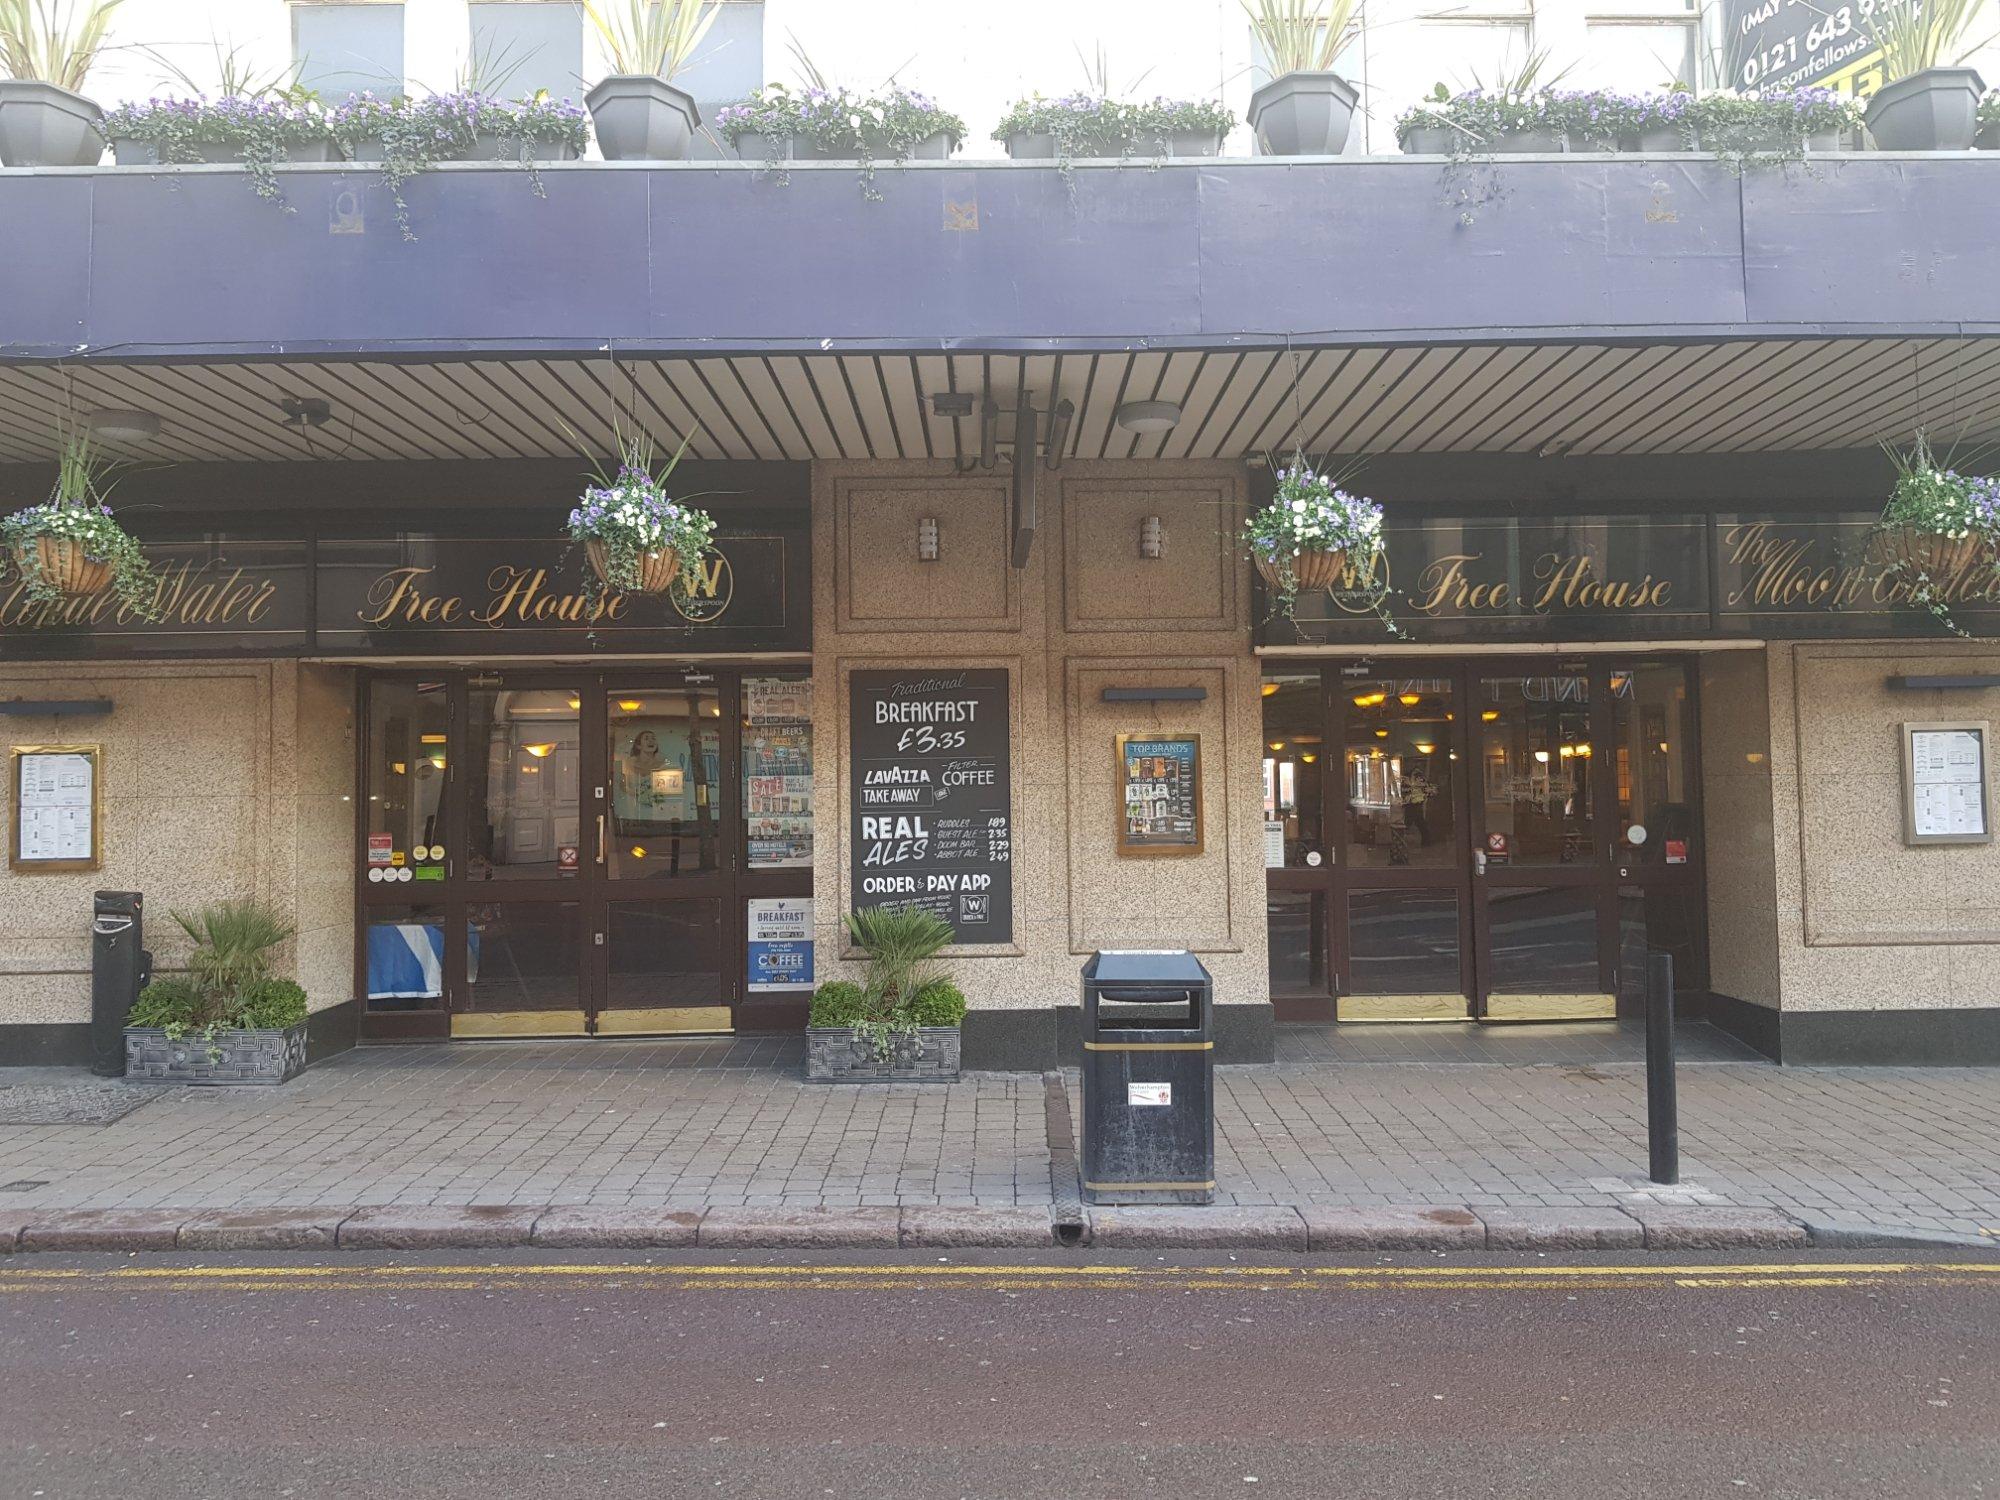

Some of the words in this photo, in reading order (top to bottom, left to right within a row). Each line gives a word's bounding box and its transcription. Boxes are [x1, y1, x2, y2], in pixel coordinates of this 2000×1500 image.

[1744, 37, 1797, 85] 0121
[1806, 7, 1851, 52] 643
[1725, 520, 1780, 564] The
[1727, 539, 1866, 605] Moon
[149, 557, 275, 625] Water
[1408, 553, 1509, 617] Free
[1516, 552, 1672, 616] House
[357, 565, 463, 629] Free
[470, 565, 629, 629] House
[891, 673, 966, 698] Traditional
[875, 700, 979, 723] BREAKFAST
[897, 726, 966, 753] £3.35
[1133, 744, 1150, 752] TOP
[1152, 744, 1188, 753] BRANDS
[947, 760, 979, 770] FILTER
[864, 766, 931, 785] LAVAZZA
[942, 770, 995, 786] COFFEE
[752, 780, 781, 796] SALE
[863, 789, 889, 803] TAKE
[890, 788, 921, 803] AWAY
[862, 816, 929, 840] REAL
[962, 829, 979, 838] ALE
[863, 838, 929, 867] ALES
[959, 840, 976, 848] BAR
[963, 848, 980, 858] ALE
[863, 876, 916, 894] ORDER
[917, 877, 925, 889] &
[927, 874, 959, 892] PAY
[960, 873, 991, 891] APP
[968, 900, 980, 911] W
[757, 912, 805, 921] BREAKFAST
[758, 955, 804, 966] COFFEE
